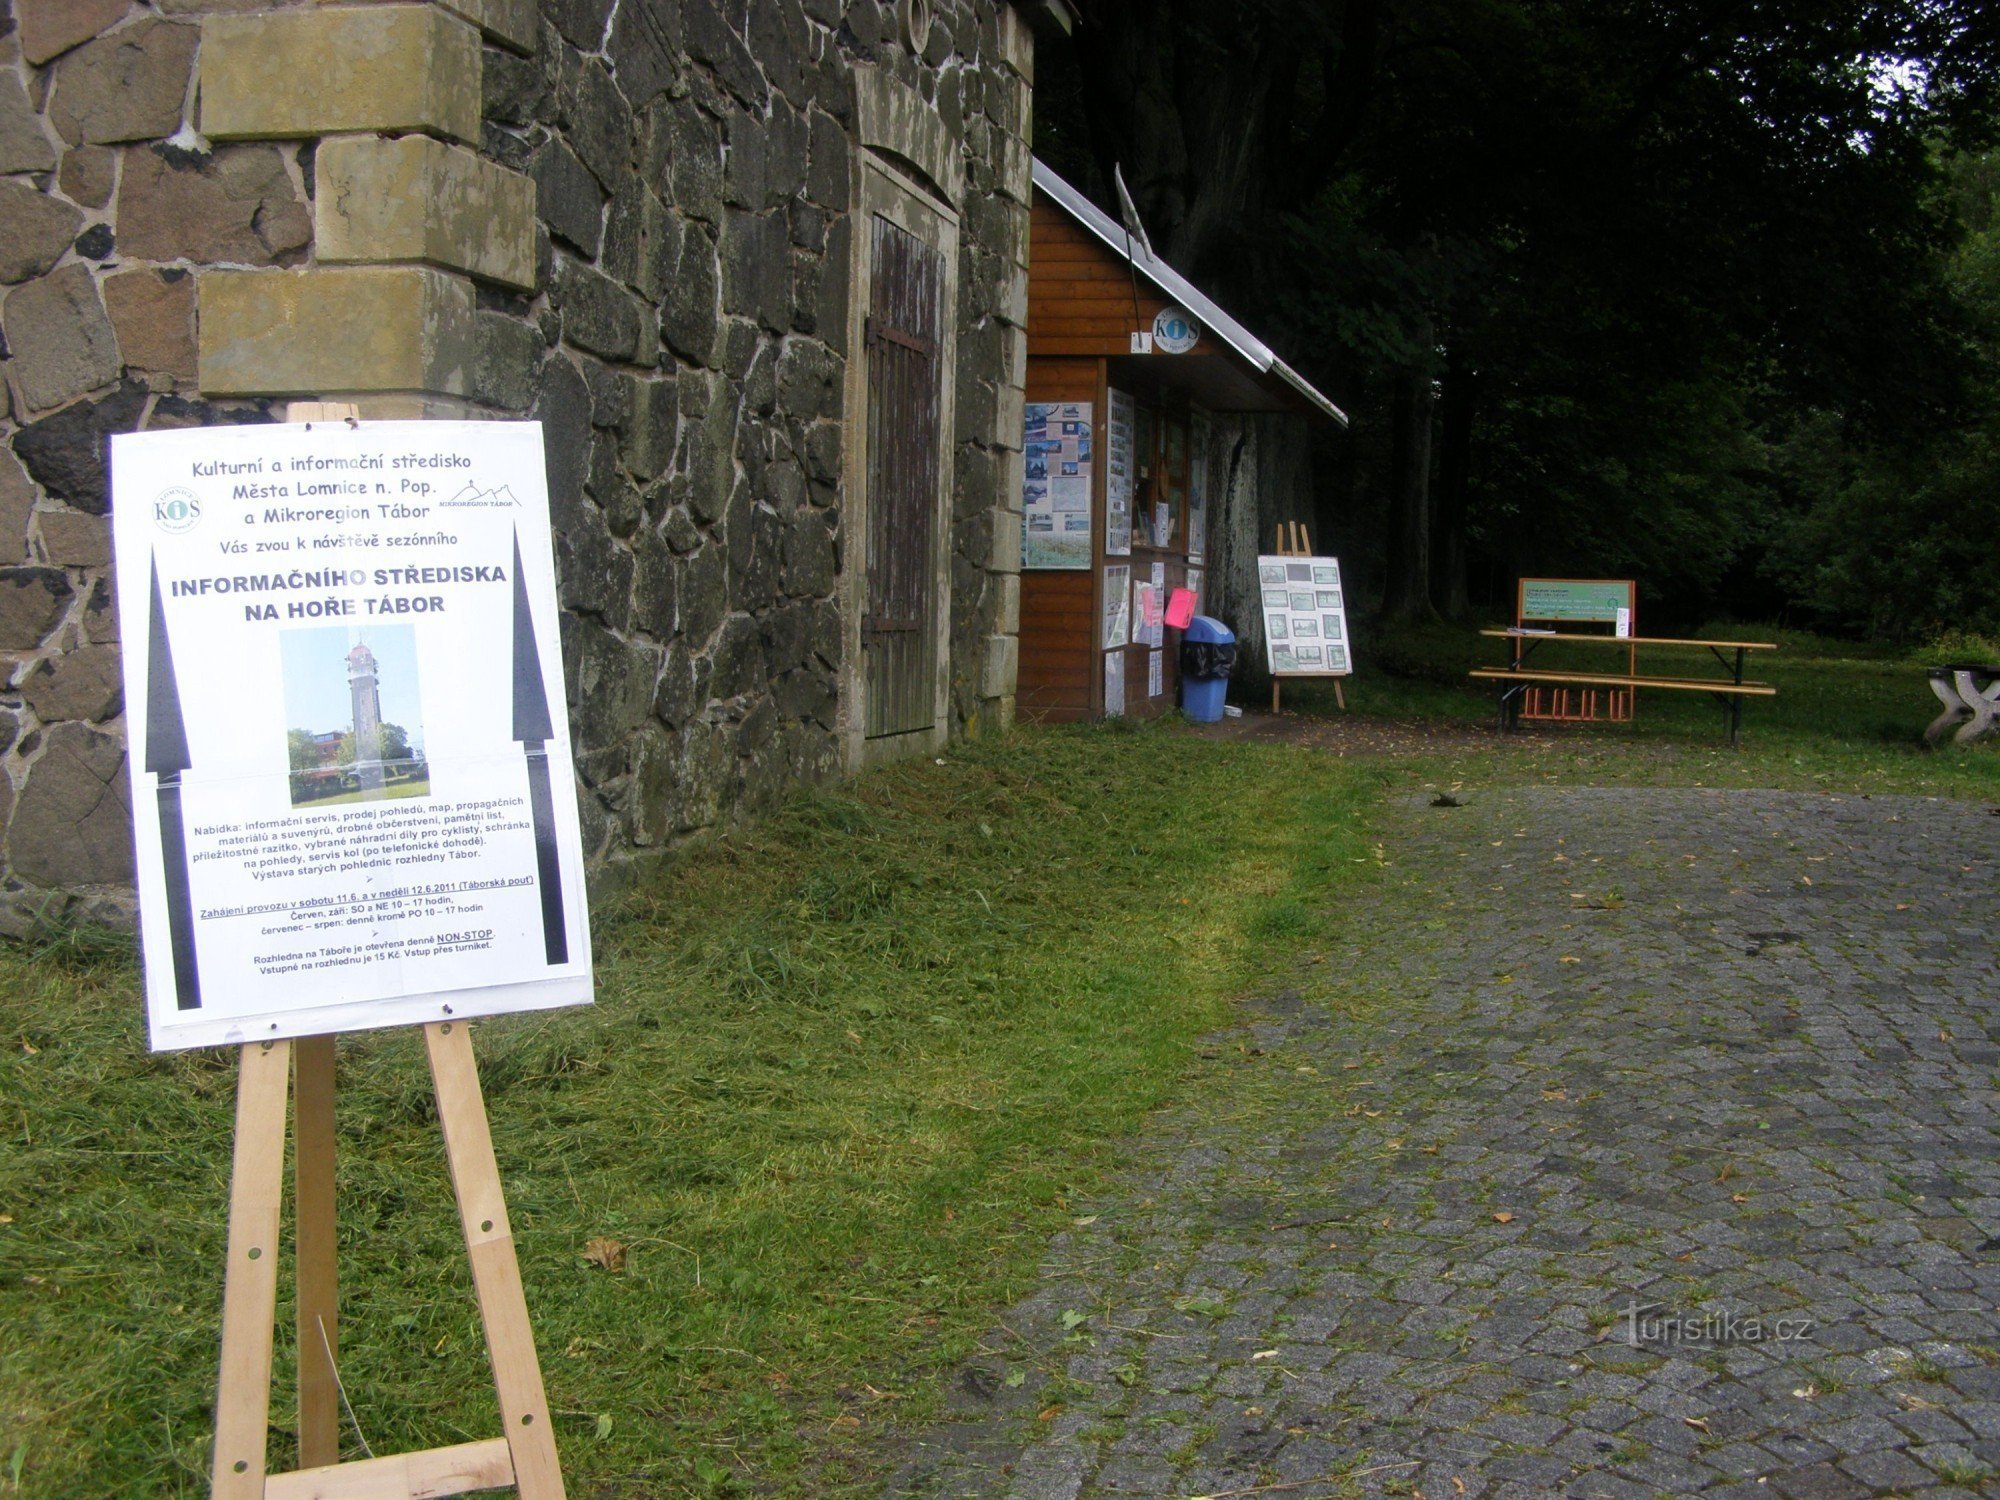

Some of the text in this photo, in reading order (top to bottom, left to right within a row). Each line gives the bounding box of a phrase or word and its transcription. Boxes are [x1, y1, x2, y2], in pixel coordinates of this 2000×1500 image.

[192, 453, 472, 478] Kulturní a informační středisko
[232, 478, 437, 500] Města Lomnice n. Pop.
[244, 503, 431, 525] a Mikroregion Tábor
[220, 531, 458, 555] Vás zvou k návštěvě sezónního
[172, 564, 508, 598] INFORMAČNÍHO STŘEDISKA
[245, 594, 446, 622] NA HOŘE TÁBOR
[246, 817, 302, 830] informační
[306, 814, 340, 824] servis,
[343, 810, 376, 822] prodej
[380, 805, 425, 818] pohledů,
[429, 805, 453, 813] map,
[219, 833, 268, 845] materiálů
[281, 827, 333, 839] suvenýrů,
[337, 822, 373, 833] drobné
[305, 837, 346, 850] vybrané
[350, 832, 396, 844] náhradní
[421, 830, 438, 839] pro
[442, 823, 482, 837] cyklisty,
[252, 851, 480, 881] Výstava starých pohlednic rozhledny Tábor.
[260, 855, 305, 868] pohledy,
[309, 851, 340, 861] servis
[344, 848, 359, 857] kol
[363, 848, 379, 858] (po
[382, 841, 439, 853] telefonické
[443, 837, 486, 848] dohodě).
[201, 906, 244, 920] Zahájení
[247, 903, 288, 914] provozu
[300, 897, 333, 908] sobotu
[412, 883, 456, 895] 12.6.2011
[459, 878, 505, 892] (Táborská
[508, 875, 534, 887] pouť)
[291, 911, 326, 920] Červen,
[351, 905, 365, 914] SO
[376, 902, 389, 911] NE
[392, 900, 402, 909] 10
[413, 898, 423, 907] 17
[262, 925, 303, 935] červenec
[314, 921, 343, 929] srpen:
[346, 915, 374, 925] denně
[377, 911, 406, 922] kromě
[408, 910, 422, 918] PO
[425, 908, 435, 916] 10
[446, 906, 455, 914] 17
[458, 904, 483, 913] hodin
[254, 953, 303, 964] Rozhledna
[319, 946, 352, 956] Táboře
[354, 945, 362, 954] je
[366, 941, 404, 951] otevřena
[407, 936, 435, 946] denně
[260, 963, 298, 974] Vstupné
[315, 957, 361, 968] rozhlednu
[363, 955, 372, 964] je
[375, 952, 385, 960] 15
[404, 949, 430, 957] Vstup
[433, 944, 453, 956] přes
